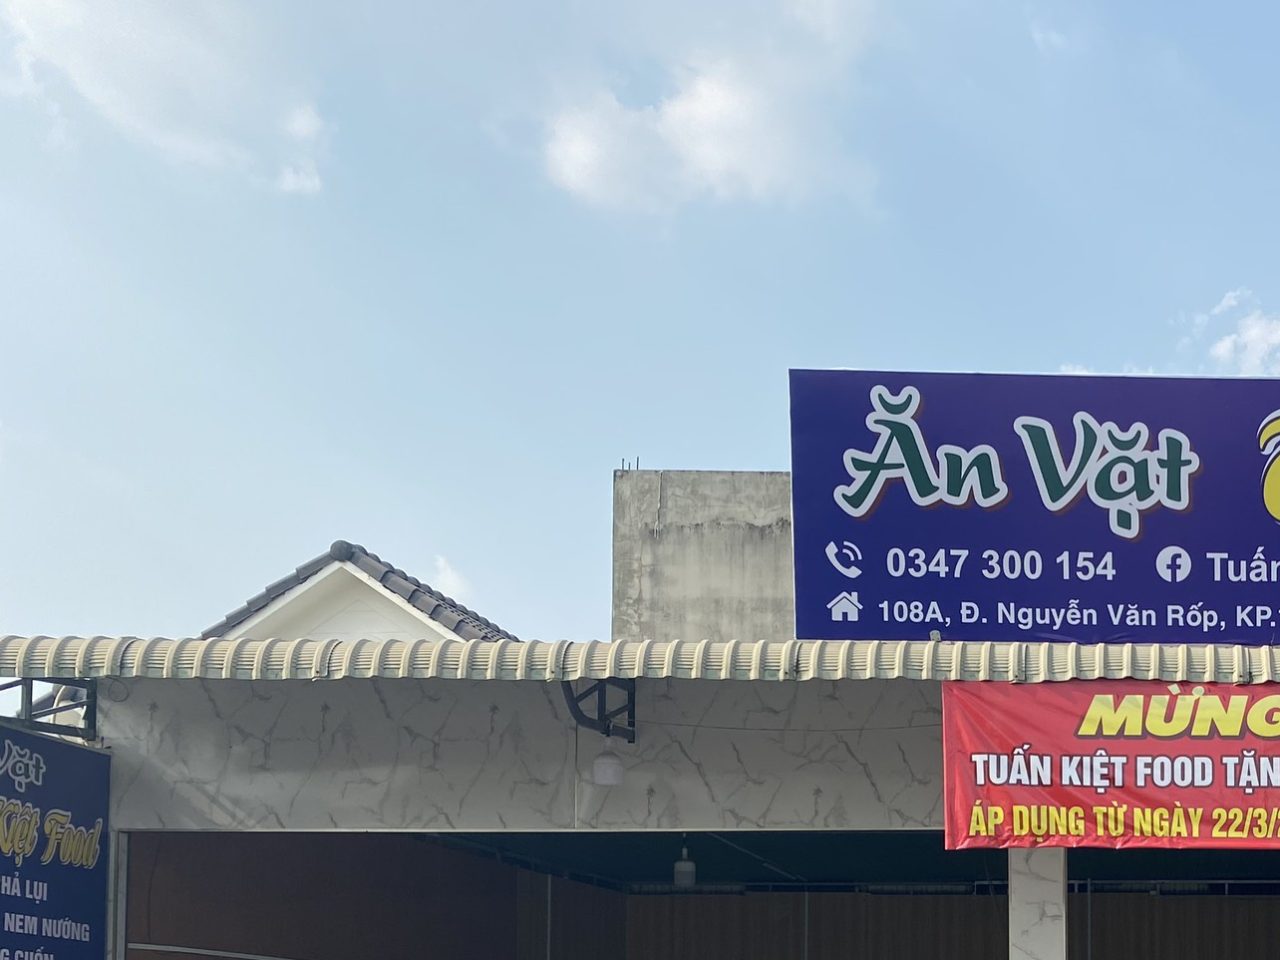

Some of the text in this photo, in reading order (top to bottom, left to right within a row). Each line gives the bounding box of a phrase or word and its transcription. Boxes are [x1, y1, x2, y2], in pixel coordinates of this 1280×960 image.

[833, 384, 1199, 539] Ăn Vặt
[886, 547, 1116, 581] 0347 300 154
[879, 600, 951, 627] 108A,
[960, 602, 988, 624] Đ.
[998, 599, 1098, 630] Nguyễn
[1107, 604, 1157, 626] Văn
[1167, 602, 1227, 632] Rốp,
[971, 744, 1051, 787] TUẤN
[1061, 748, 1128, 794] KIỆT
[1136, 755, 1213, 787] FOOD
[41, 808, 102, 869] Food
[969, 800, 1005, 836] ÁP
[1012, 805, 1085, 842] DỤNG
[1092, 801, 1128, 837] TỪ
[1134, 801, 1203, 838] NGÀY
[1, 872, 48, 904] HẢ LỤI
[4, 912, 90, 942] NEM NƯỚNG
